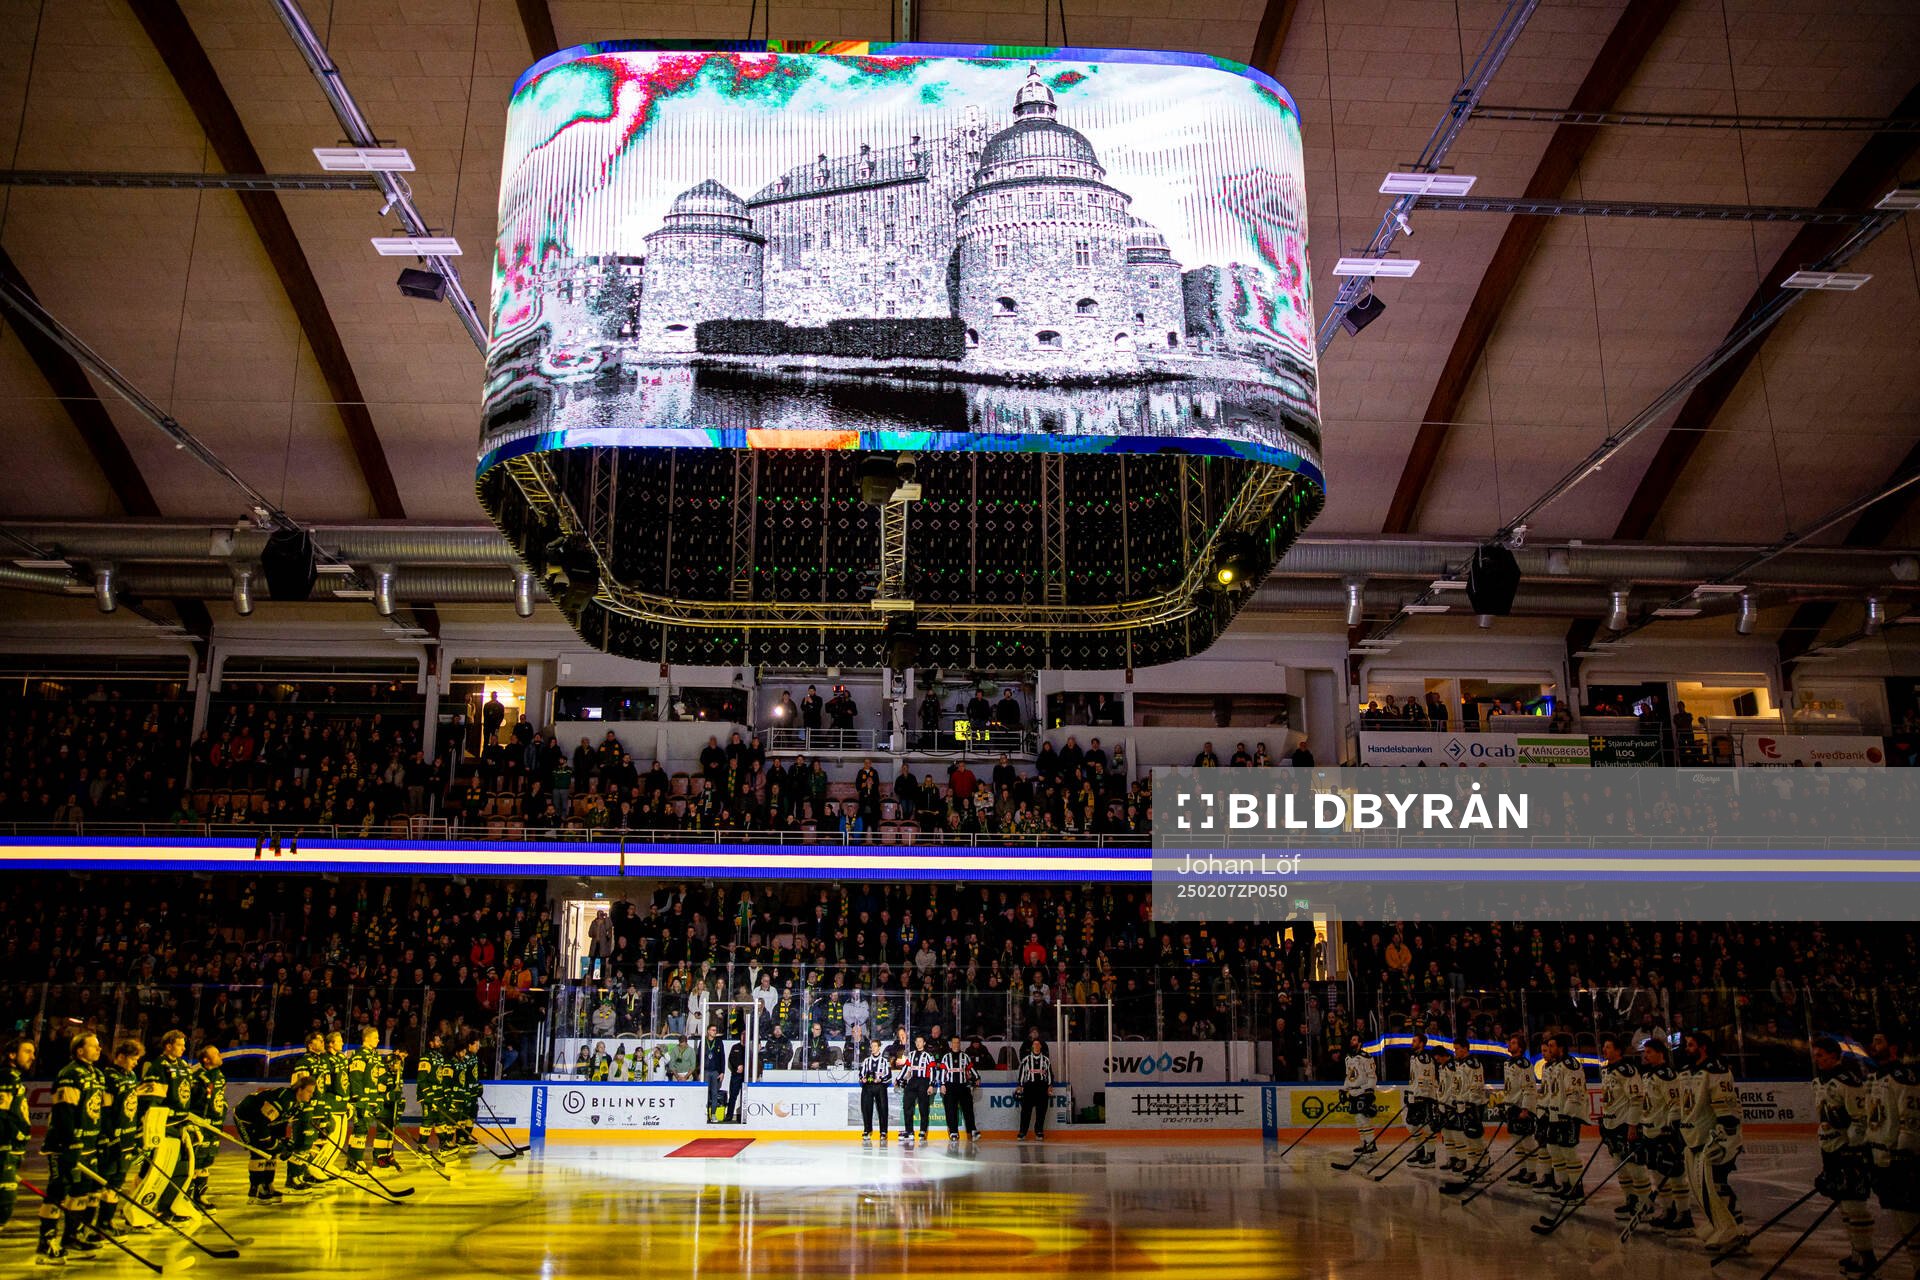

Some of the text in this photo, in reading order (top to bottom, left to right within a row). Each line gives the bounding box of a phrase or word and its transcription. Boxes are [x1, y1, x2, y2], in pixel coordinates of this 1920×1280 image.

[1367, 744, 1433, 754] Handelsbanken
[1469, 743, 1515, 758] Ocab
[1532, 745, 1589, 756] MÅNGBERGS
[1811, 750, 1865, 760] Swedbank
[1103, 1051, 1204, 1075] swoosh
[1765, 1091, 1775, 1102] &
[591, 1098, 677, 1109] BILINVEST
[1778, 1108, 1794, 1119] AB
